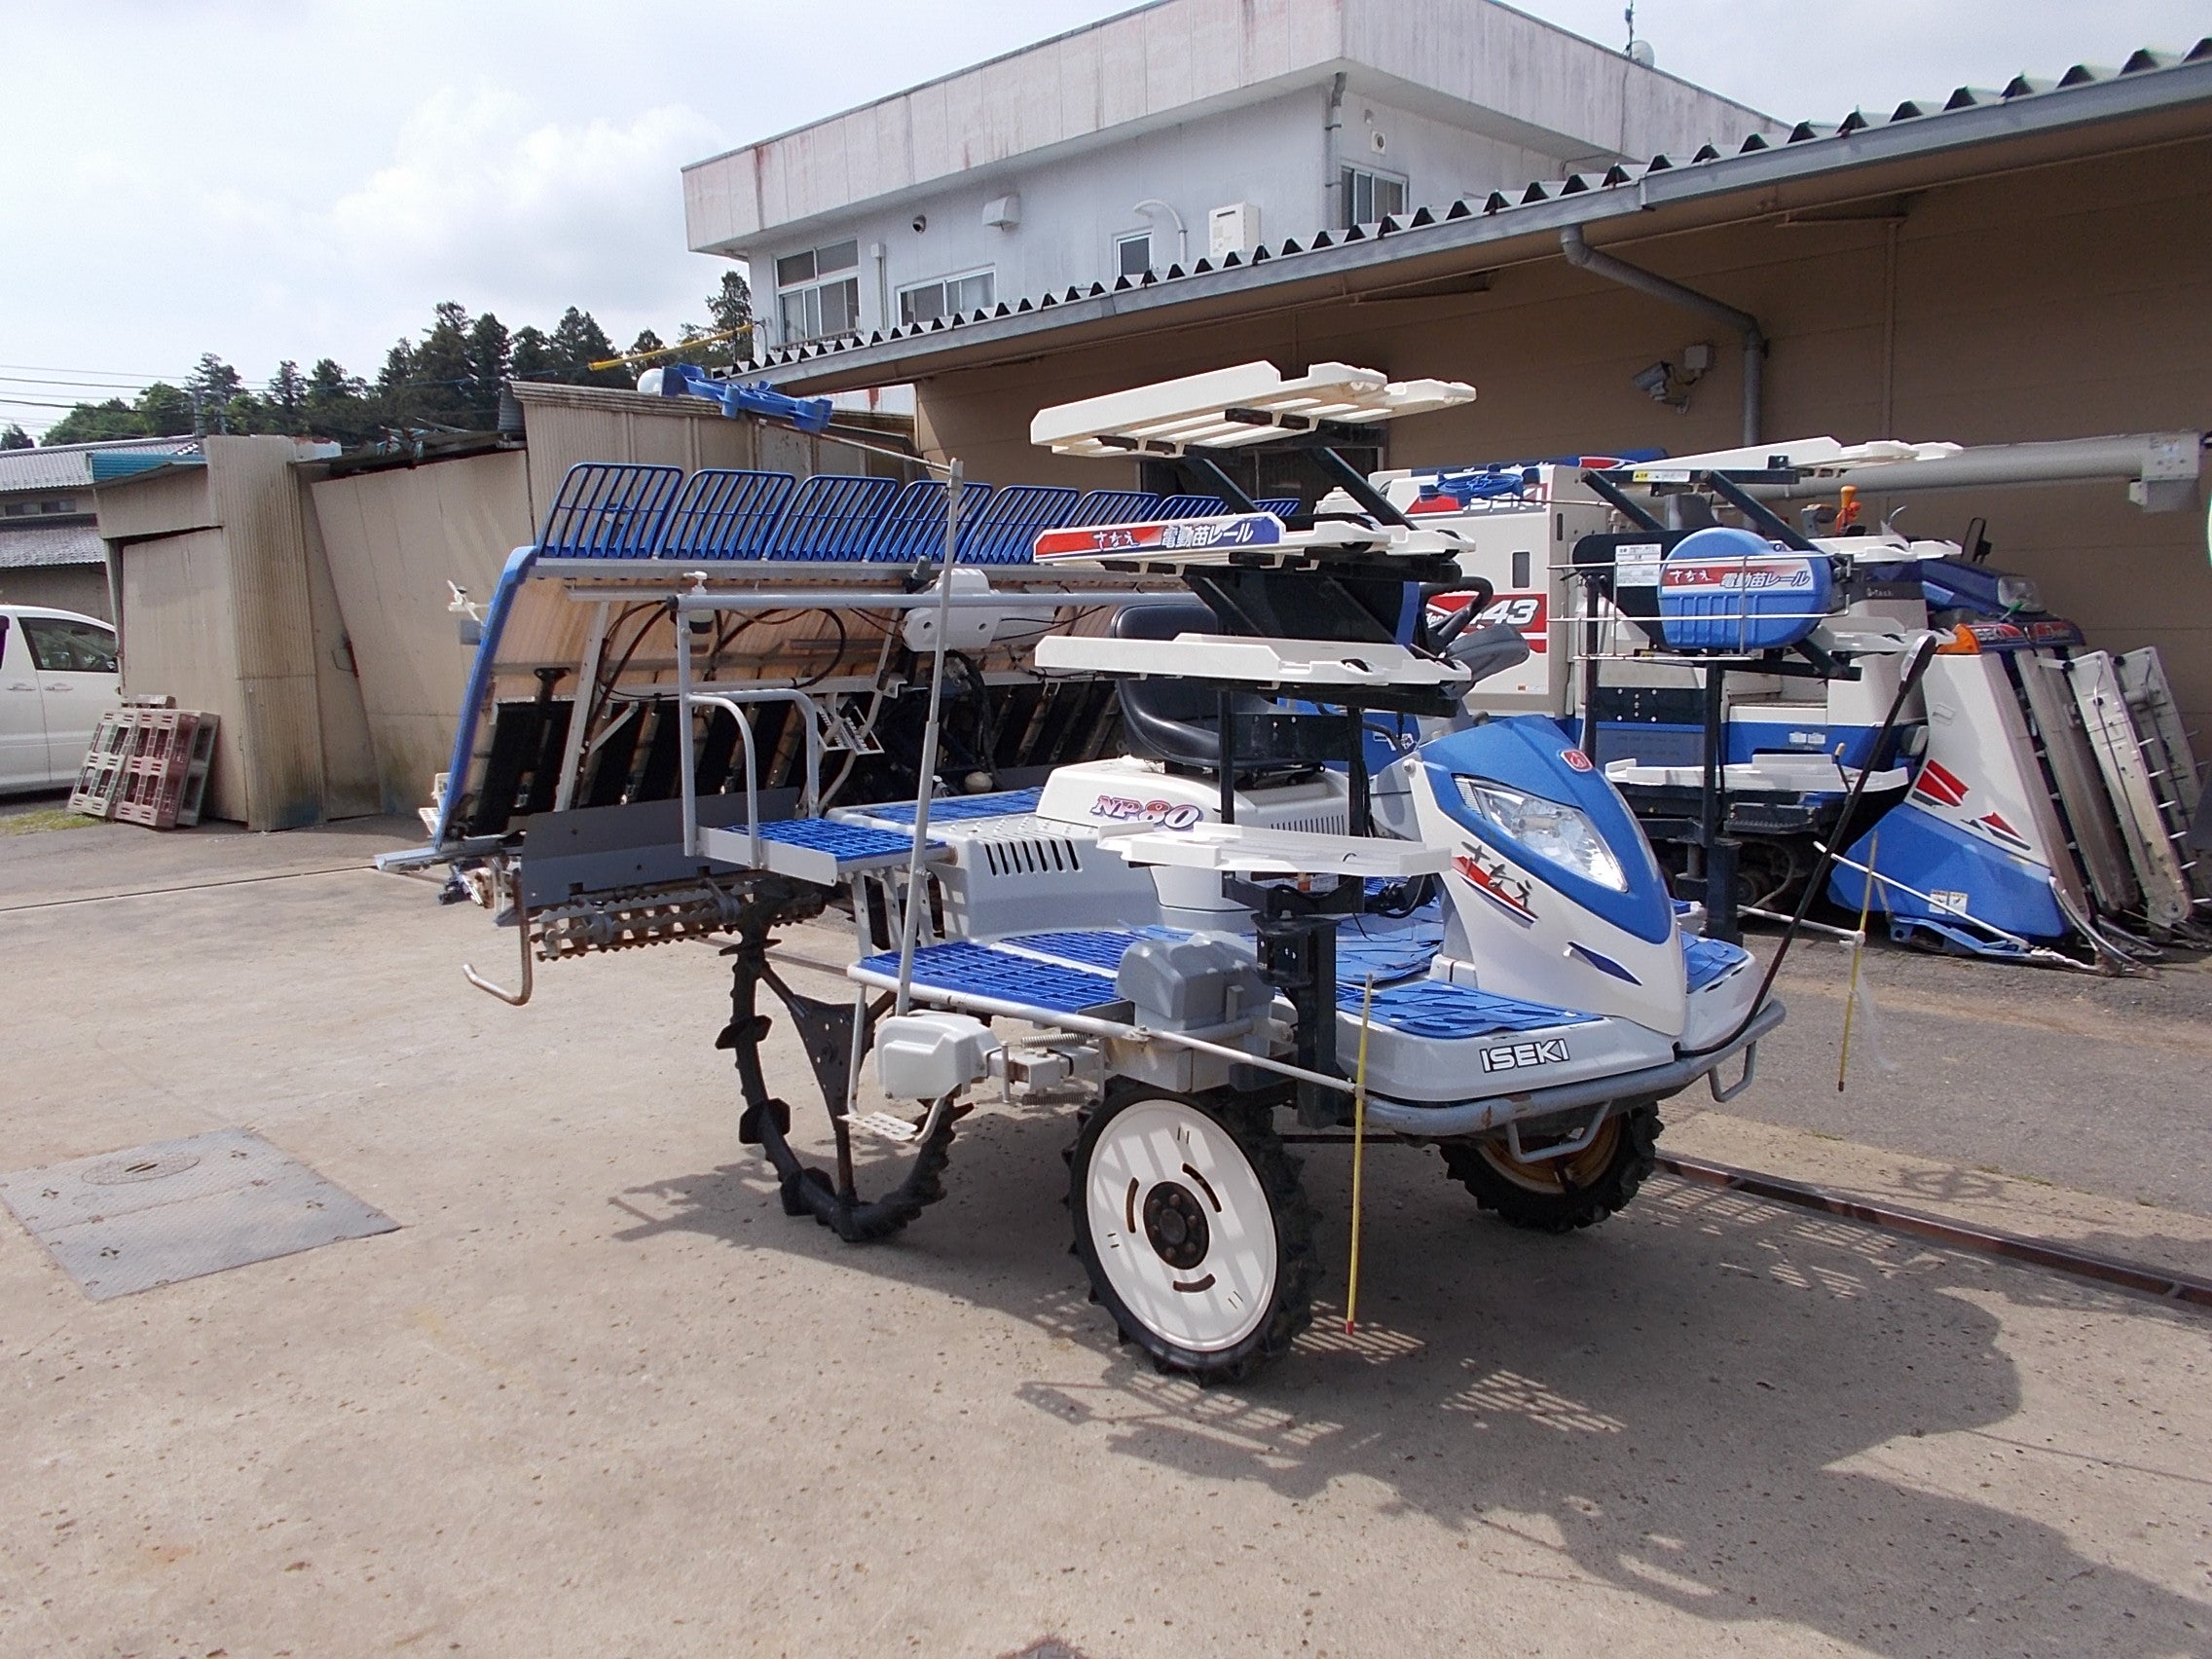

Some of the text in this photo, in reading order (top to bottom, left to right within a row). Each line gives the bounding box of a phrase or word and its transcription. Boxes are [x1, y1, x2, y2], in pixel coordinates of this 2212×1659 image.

[1462, 486, 1544, 511] SEKI
[1092, 523, 1254, 552] さなえ 電動苗レール
[1669, 570, 1714, 584] さなえ
[1719, 571, 1811, 589] 電動苗レール
[1469, 598, 1539, 626] 43
[1090, 794, 1204, 832] NP80
[1460, 840, 1533, 909] さなえ
[1479, 1038, 1570, 1073] ISEKI
